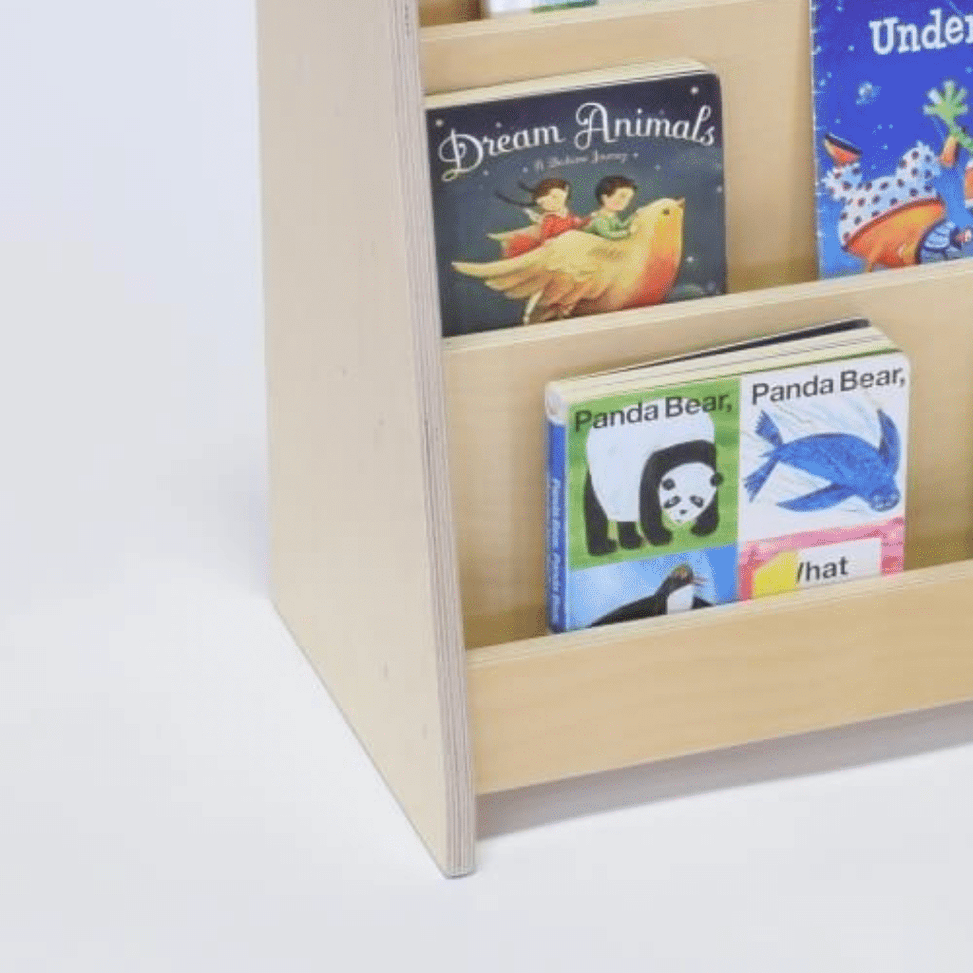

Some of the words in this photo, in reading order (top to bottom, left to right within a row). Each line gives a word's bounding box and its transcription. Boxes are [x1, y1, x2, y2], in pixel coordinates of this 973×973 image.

[438, 124, 566, 182] Dream
[573, 102, 716, 150] Animals
[751, 374, 835, 406] Panda
[839, 365, 907, 394] Bear,
[574, 401, 660, 433] Panda
[664, 390, 734, 420] Bear,
[796, 557, 849, 584] hat
